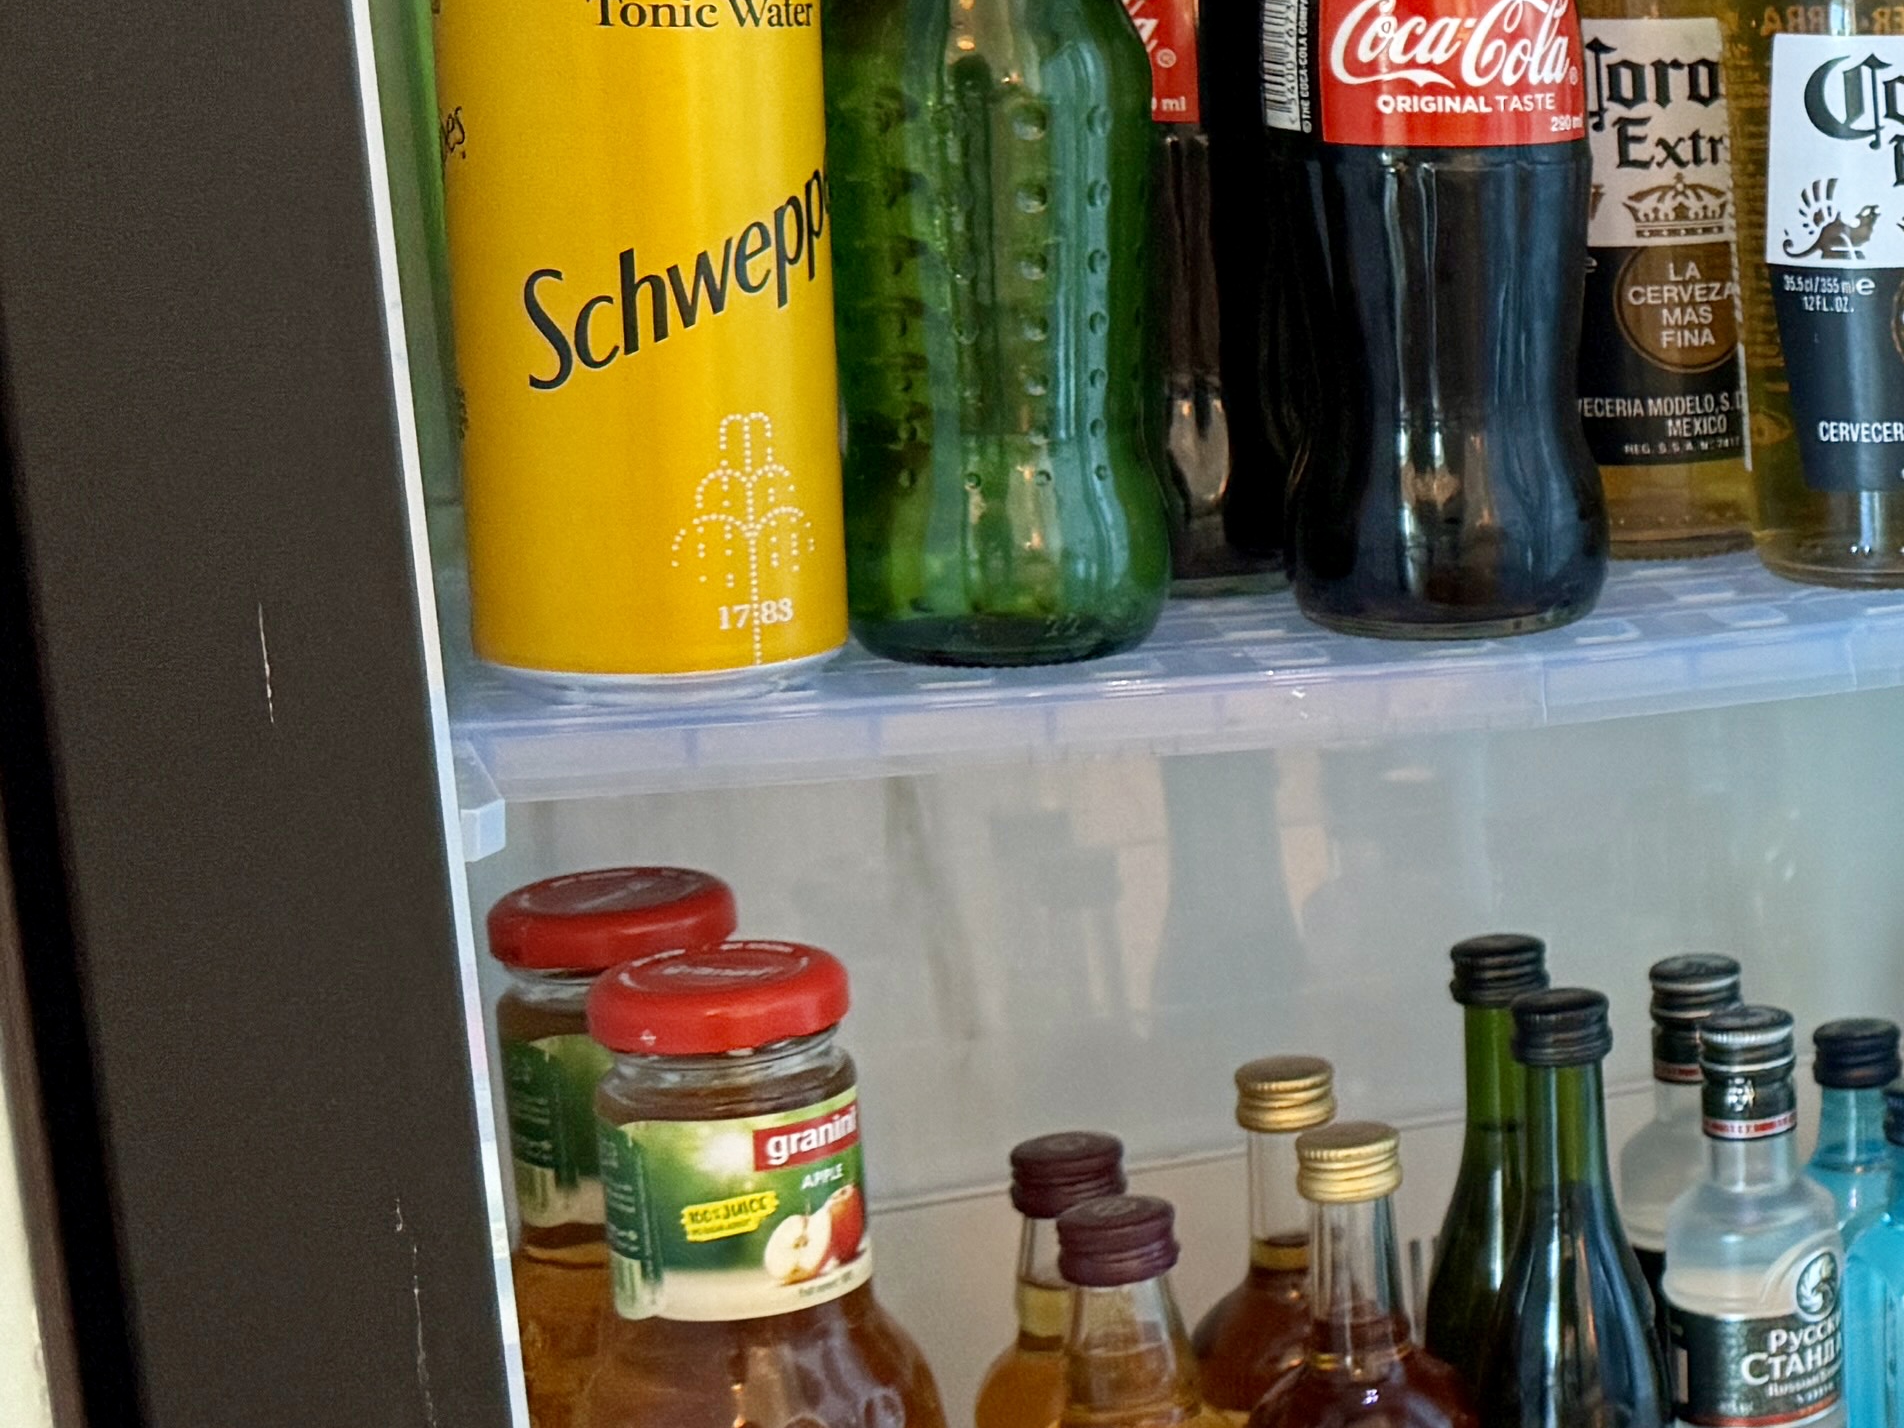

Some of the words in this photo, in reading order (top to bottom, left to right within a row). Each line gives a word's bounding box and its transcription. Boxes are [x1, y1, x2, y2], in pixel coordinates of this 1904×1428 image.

[1298, 38, 1310, 97] COCA-COLA
[1301, 100, 1311, 120] THE
[1377, 94, 1492, 114] ORIGINAL
[1497, 93, 1556, 113] TASTE
[523, 168, 830, 392] Schwepp
[1669, 261, 1701, 282] LA
[1628, 282, 1740, 305] CERVEZA
[1662, 304, 1713, 326] MAS
[1661, 327, 1716, 349] FINA
[1666, 413, 1728, 438] MEXICO
